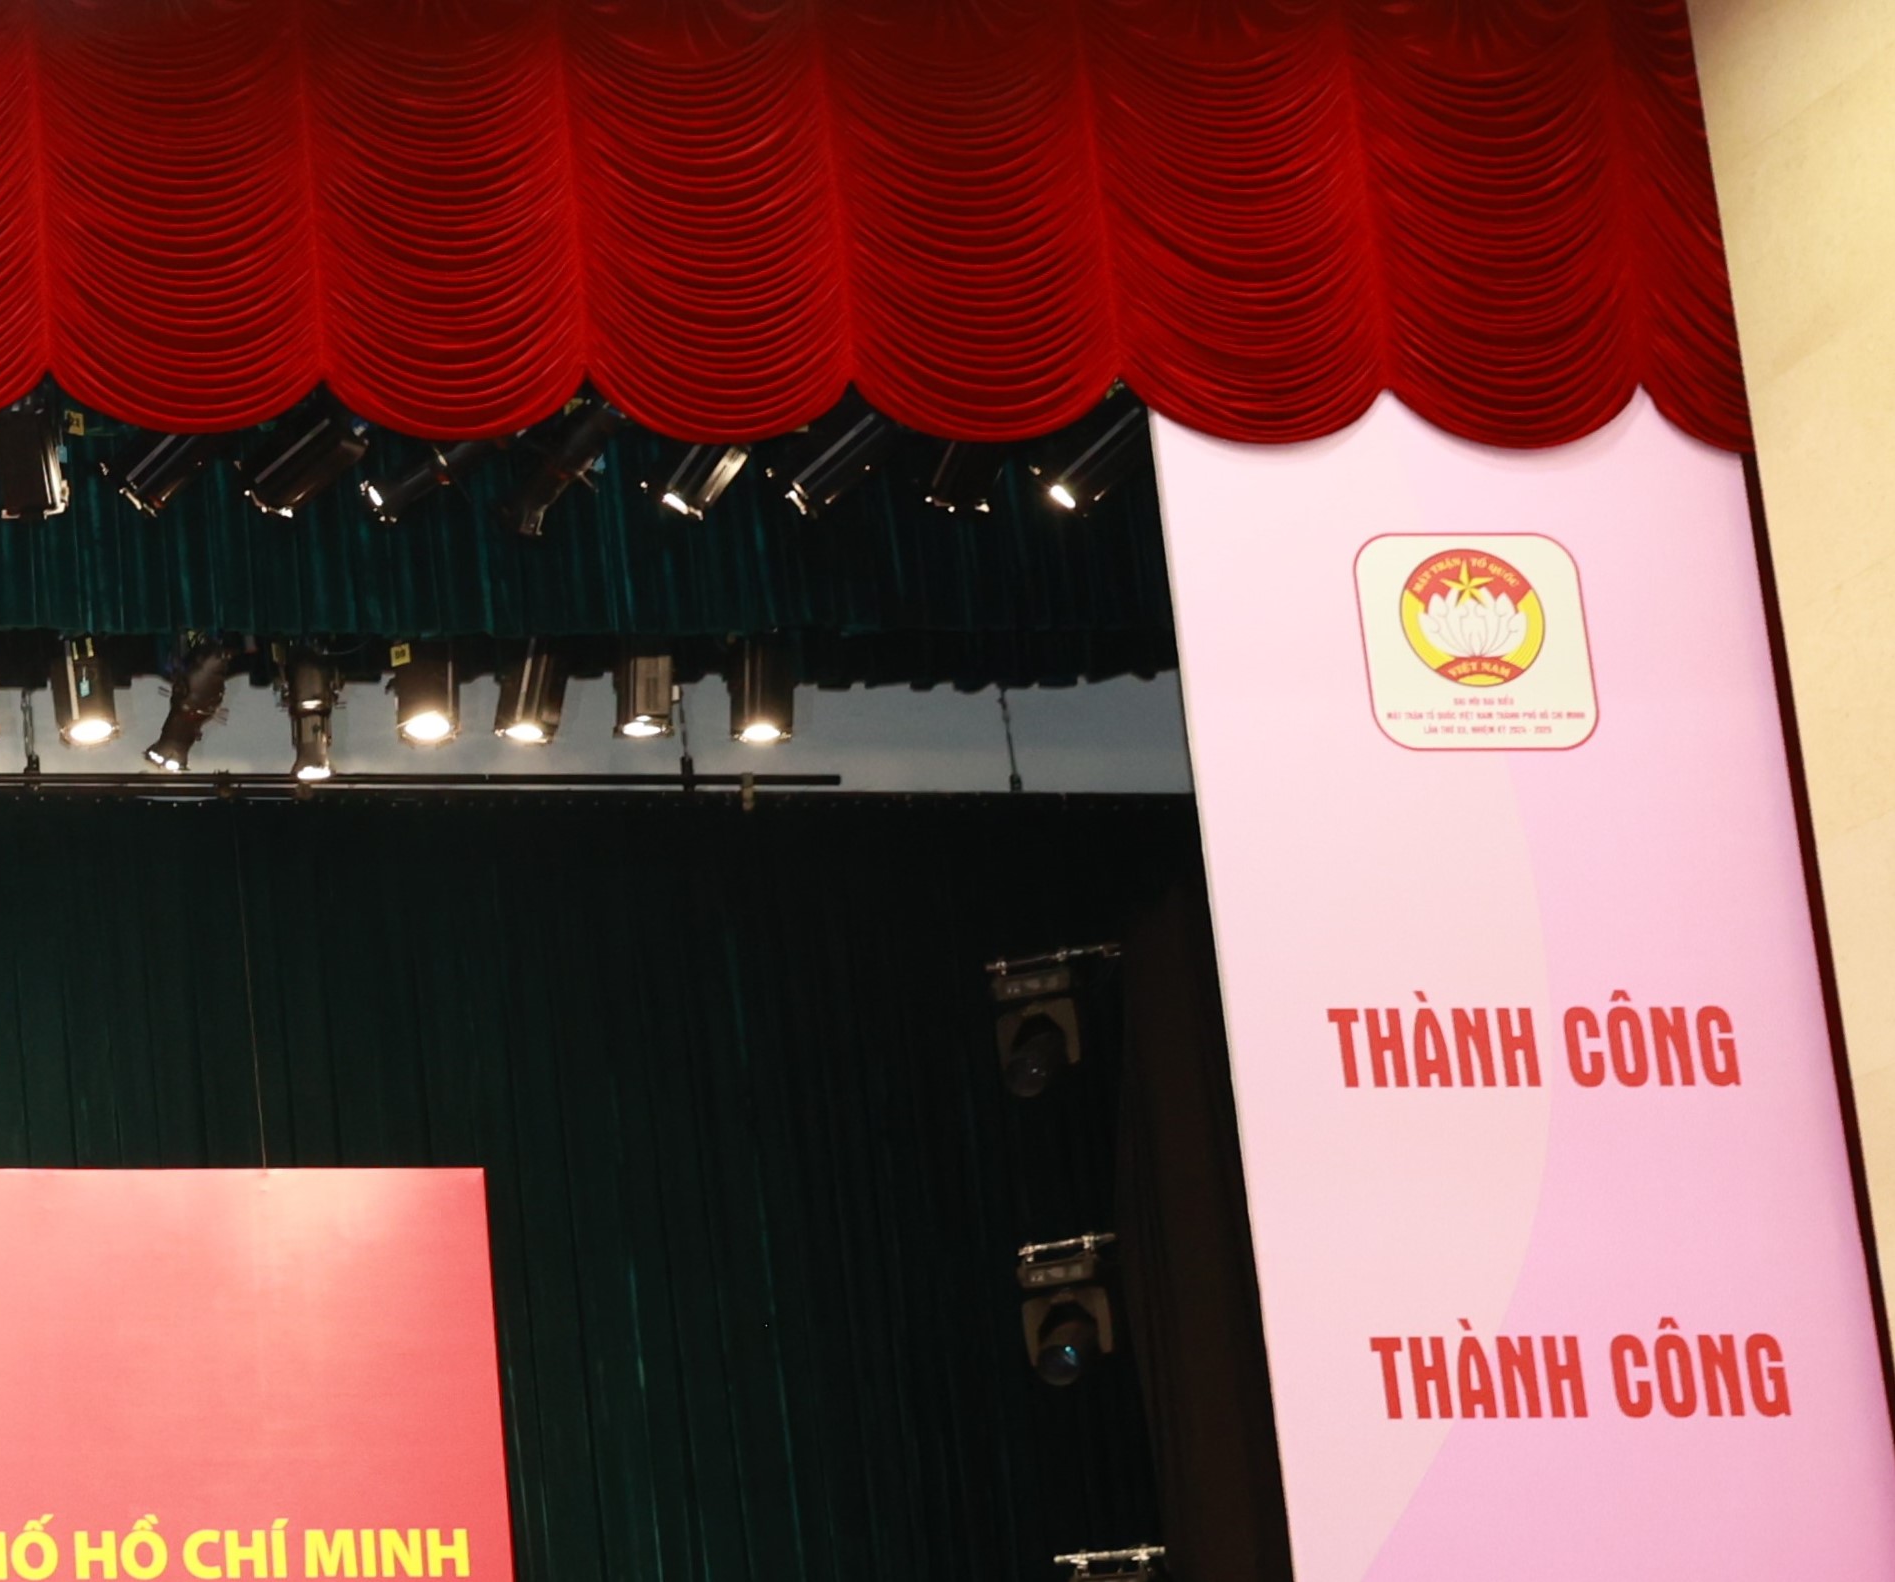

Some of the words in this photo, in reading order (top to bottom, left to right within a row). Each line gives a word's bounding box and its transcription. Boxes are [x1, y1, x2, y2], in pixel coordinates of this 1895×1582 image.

[1328, 990, 1542, 1088] THÀNH
[1564, 989, 1741, 1087] CÔNG
[1371, 1319, 1589, 1419] THÀNH
[1610, 1317, 1792, 1418] CÔNG
[73, 1514, 169, 1580] HỒ
[182, 1518, 288, 1580] CHÍ
[304, 1528, 470, 1579] MINH
